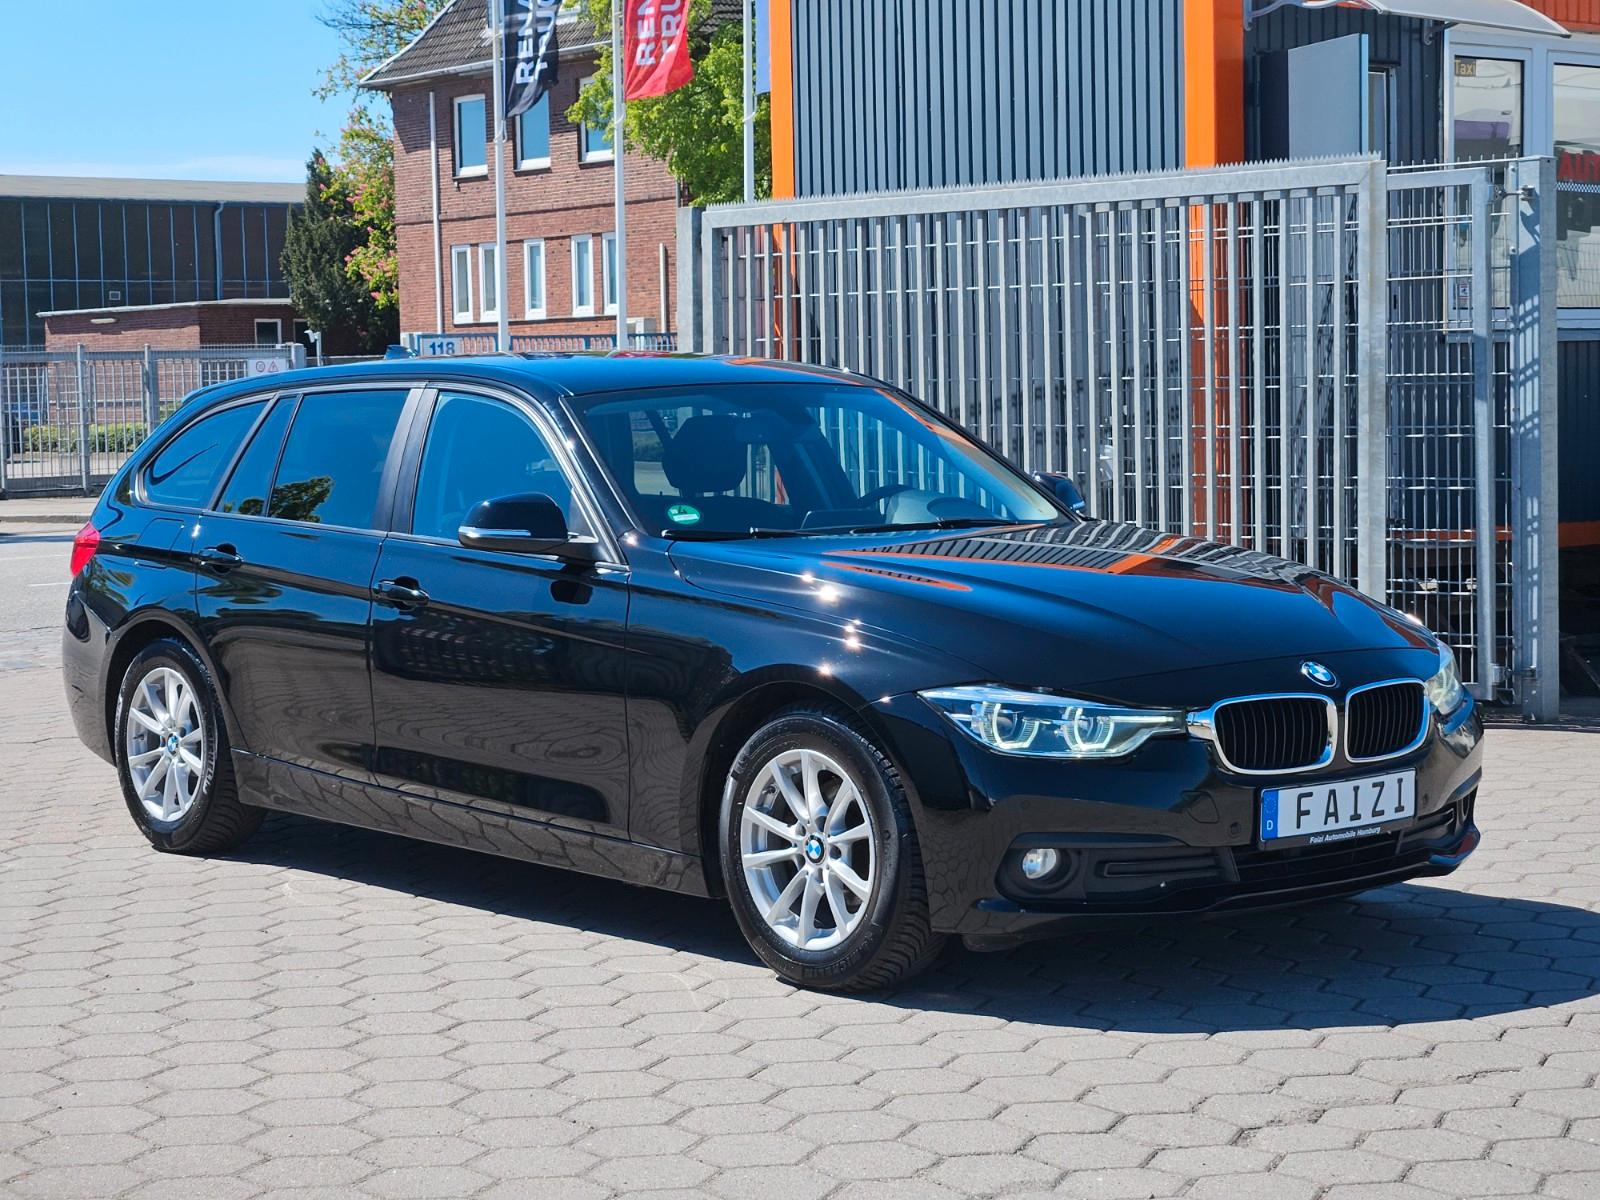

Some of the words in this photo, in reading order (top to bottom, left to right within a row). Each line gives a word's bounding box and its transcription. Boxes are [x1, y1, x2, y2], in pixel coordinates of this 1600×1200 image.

[429, 341, 455, 356] 118
[1296, 777, 1405, 830] FAIZI
[1266, 819, 1274, 831] D
